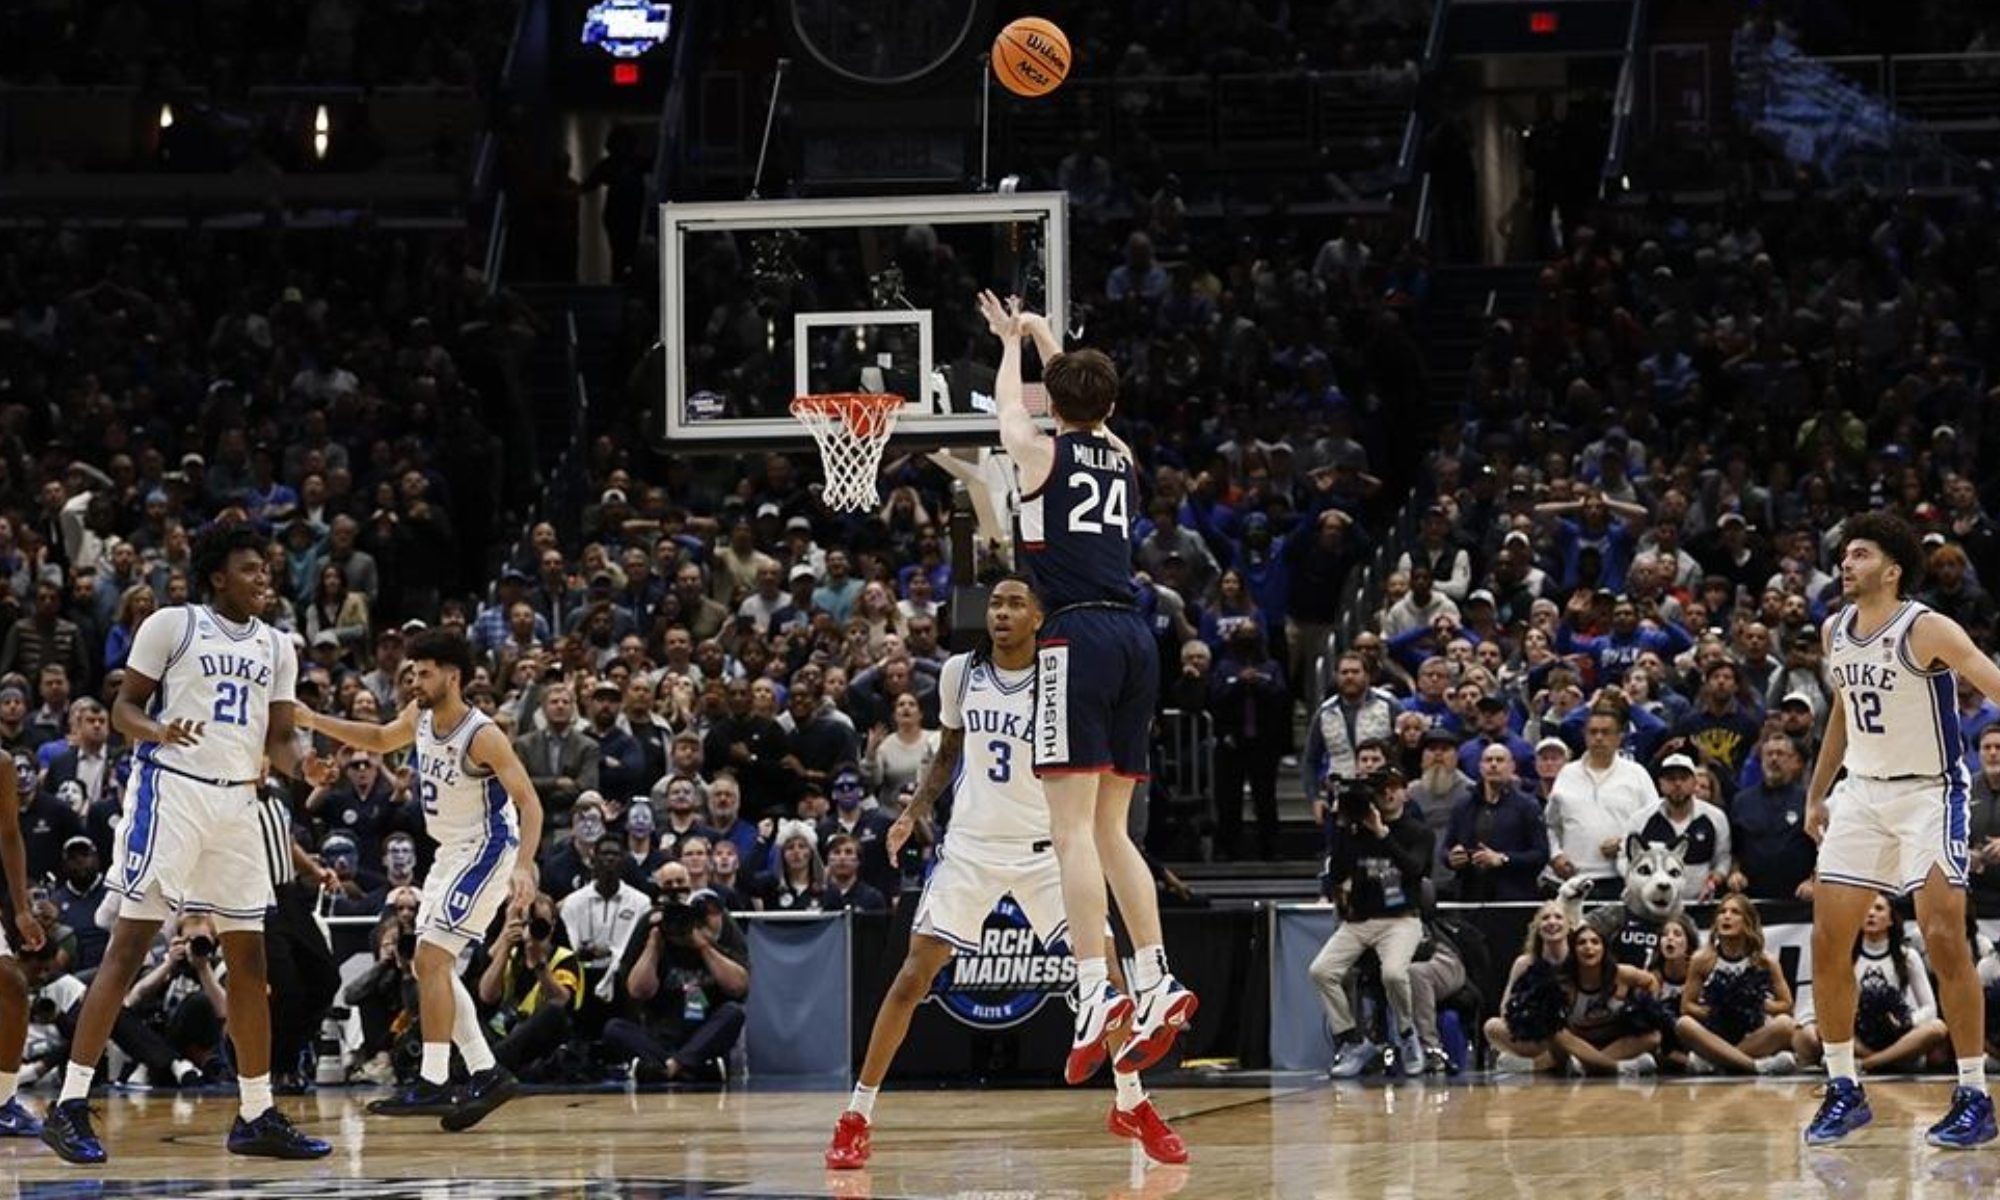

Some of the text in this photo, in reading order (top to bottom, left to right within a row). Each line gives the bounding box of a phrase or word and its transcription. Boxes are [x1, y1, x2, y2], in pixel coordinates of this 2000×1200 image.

[1026, 34, 1065, 72] Wilson
[1072, 443, 1126, 473] MULLINS
[1068, 471, 1128, 539] 24
[199, 654, 272, 687] DUKE
[1833, 664, 1896, 692] DUKE
[214, 682, 249, 726] 21
[1043, 655, 1058, 758] HUSKIES
[1849, 691, 1886, 734] 12
[967, 709, 1035, 744] DUKE
[421, 753, 459, 786] UKE
[988, 741, 1012, 783] 3
[422, 780, 439, 816] 2
[976, 928, 1035, 956] RCH
[1621, 932, 1658, 946] UCO
[953, 955, 1076, 985] MADNESS
